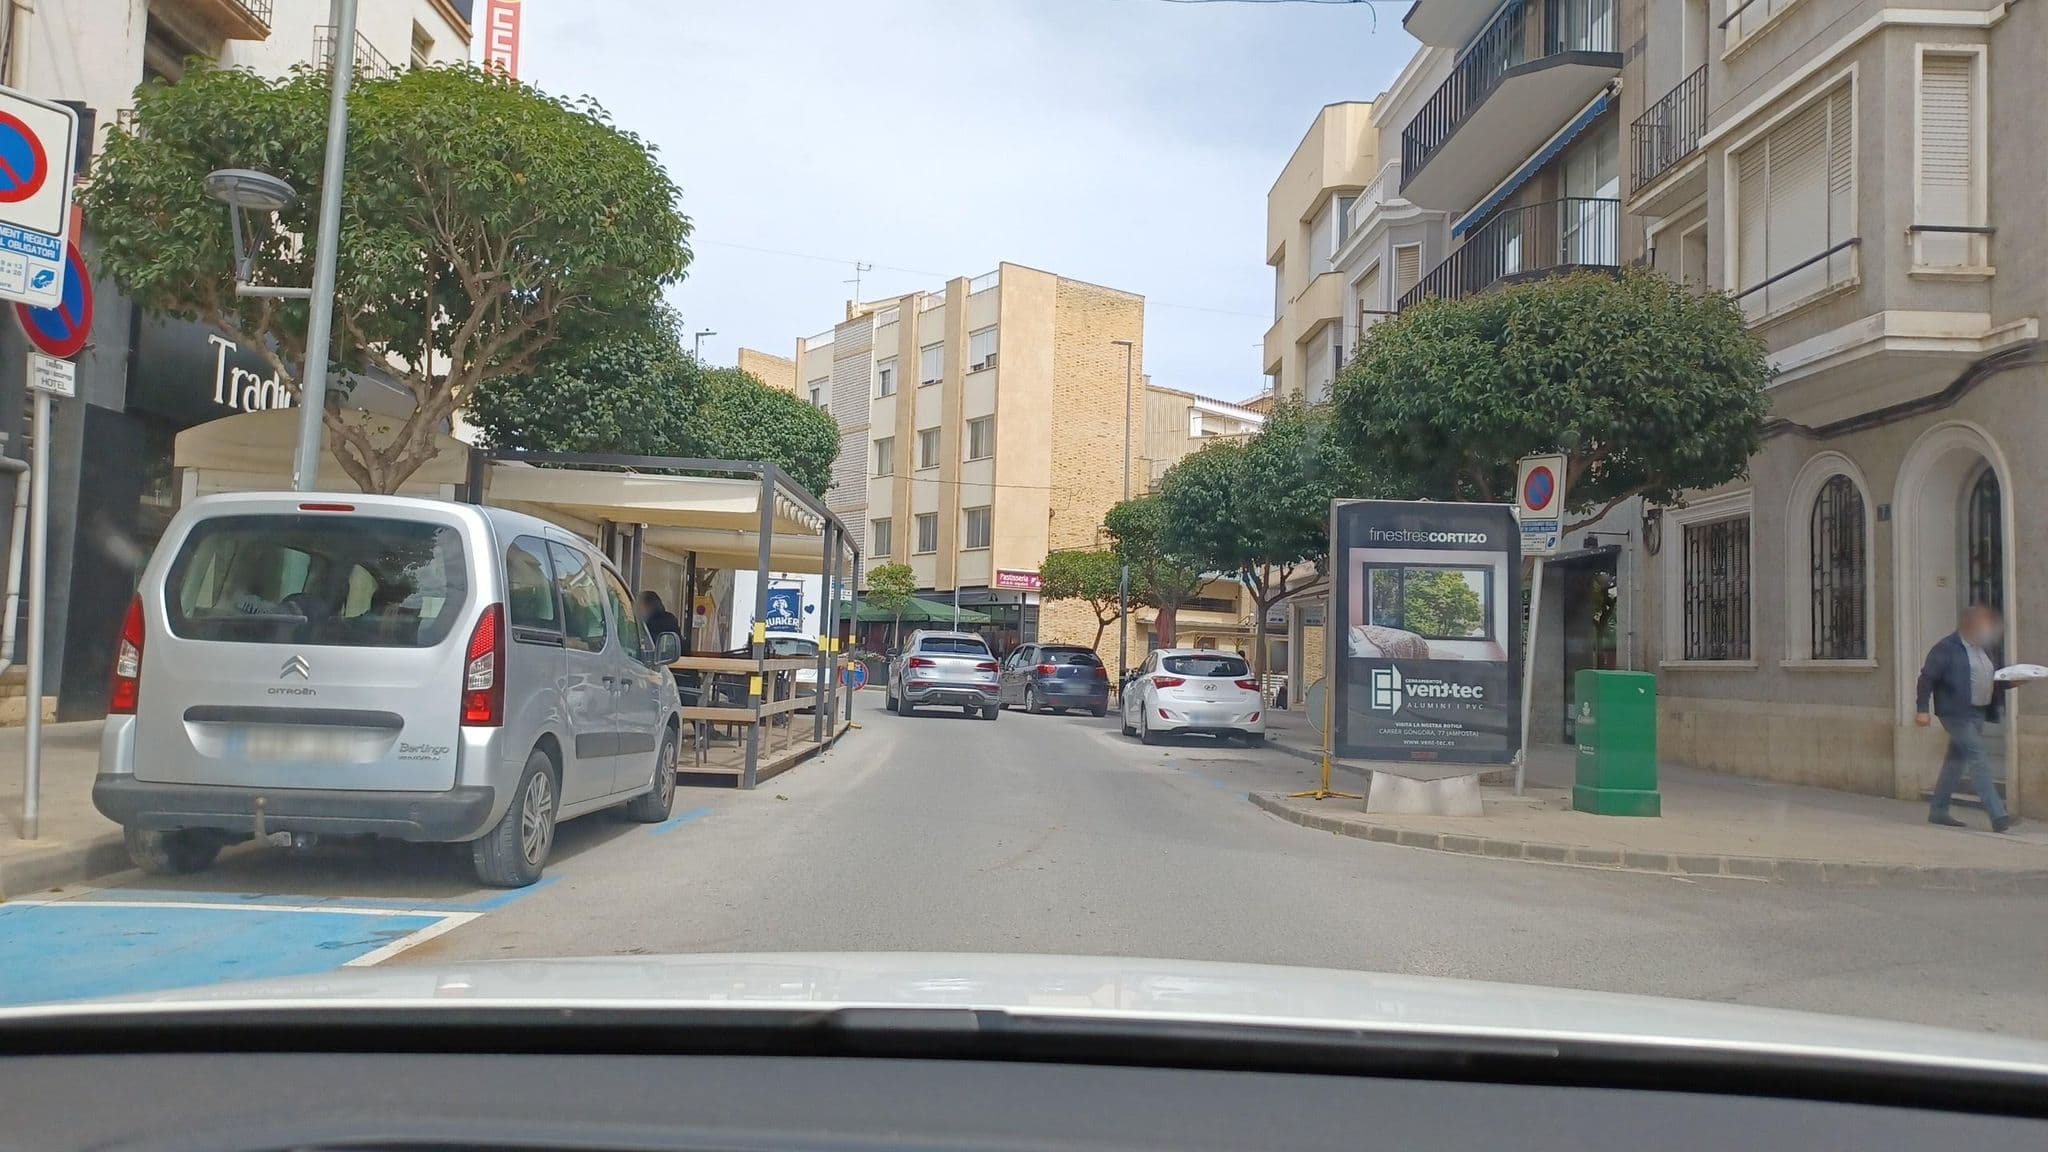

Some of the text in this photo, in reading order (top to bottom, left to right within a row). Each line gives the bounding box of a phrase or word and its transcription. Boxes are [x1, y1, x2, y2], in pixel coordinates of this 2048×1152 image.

[7, 239, 56, 259] OBLIGATORI
[23, 232, 60, 251] REGULAT
[41, 377, 67, 391] HOTEL
[399, 742, 450, 755] Berlingo
